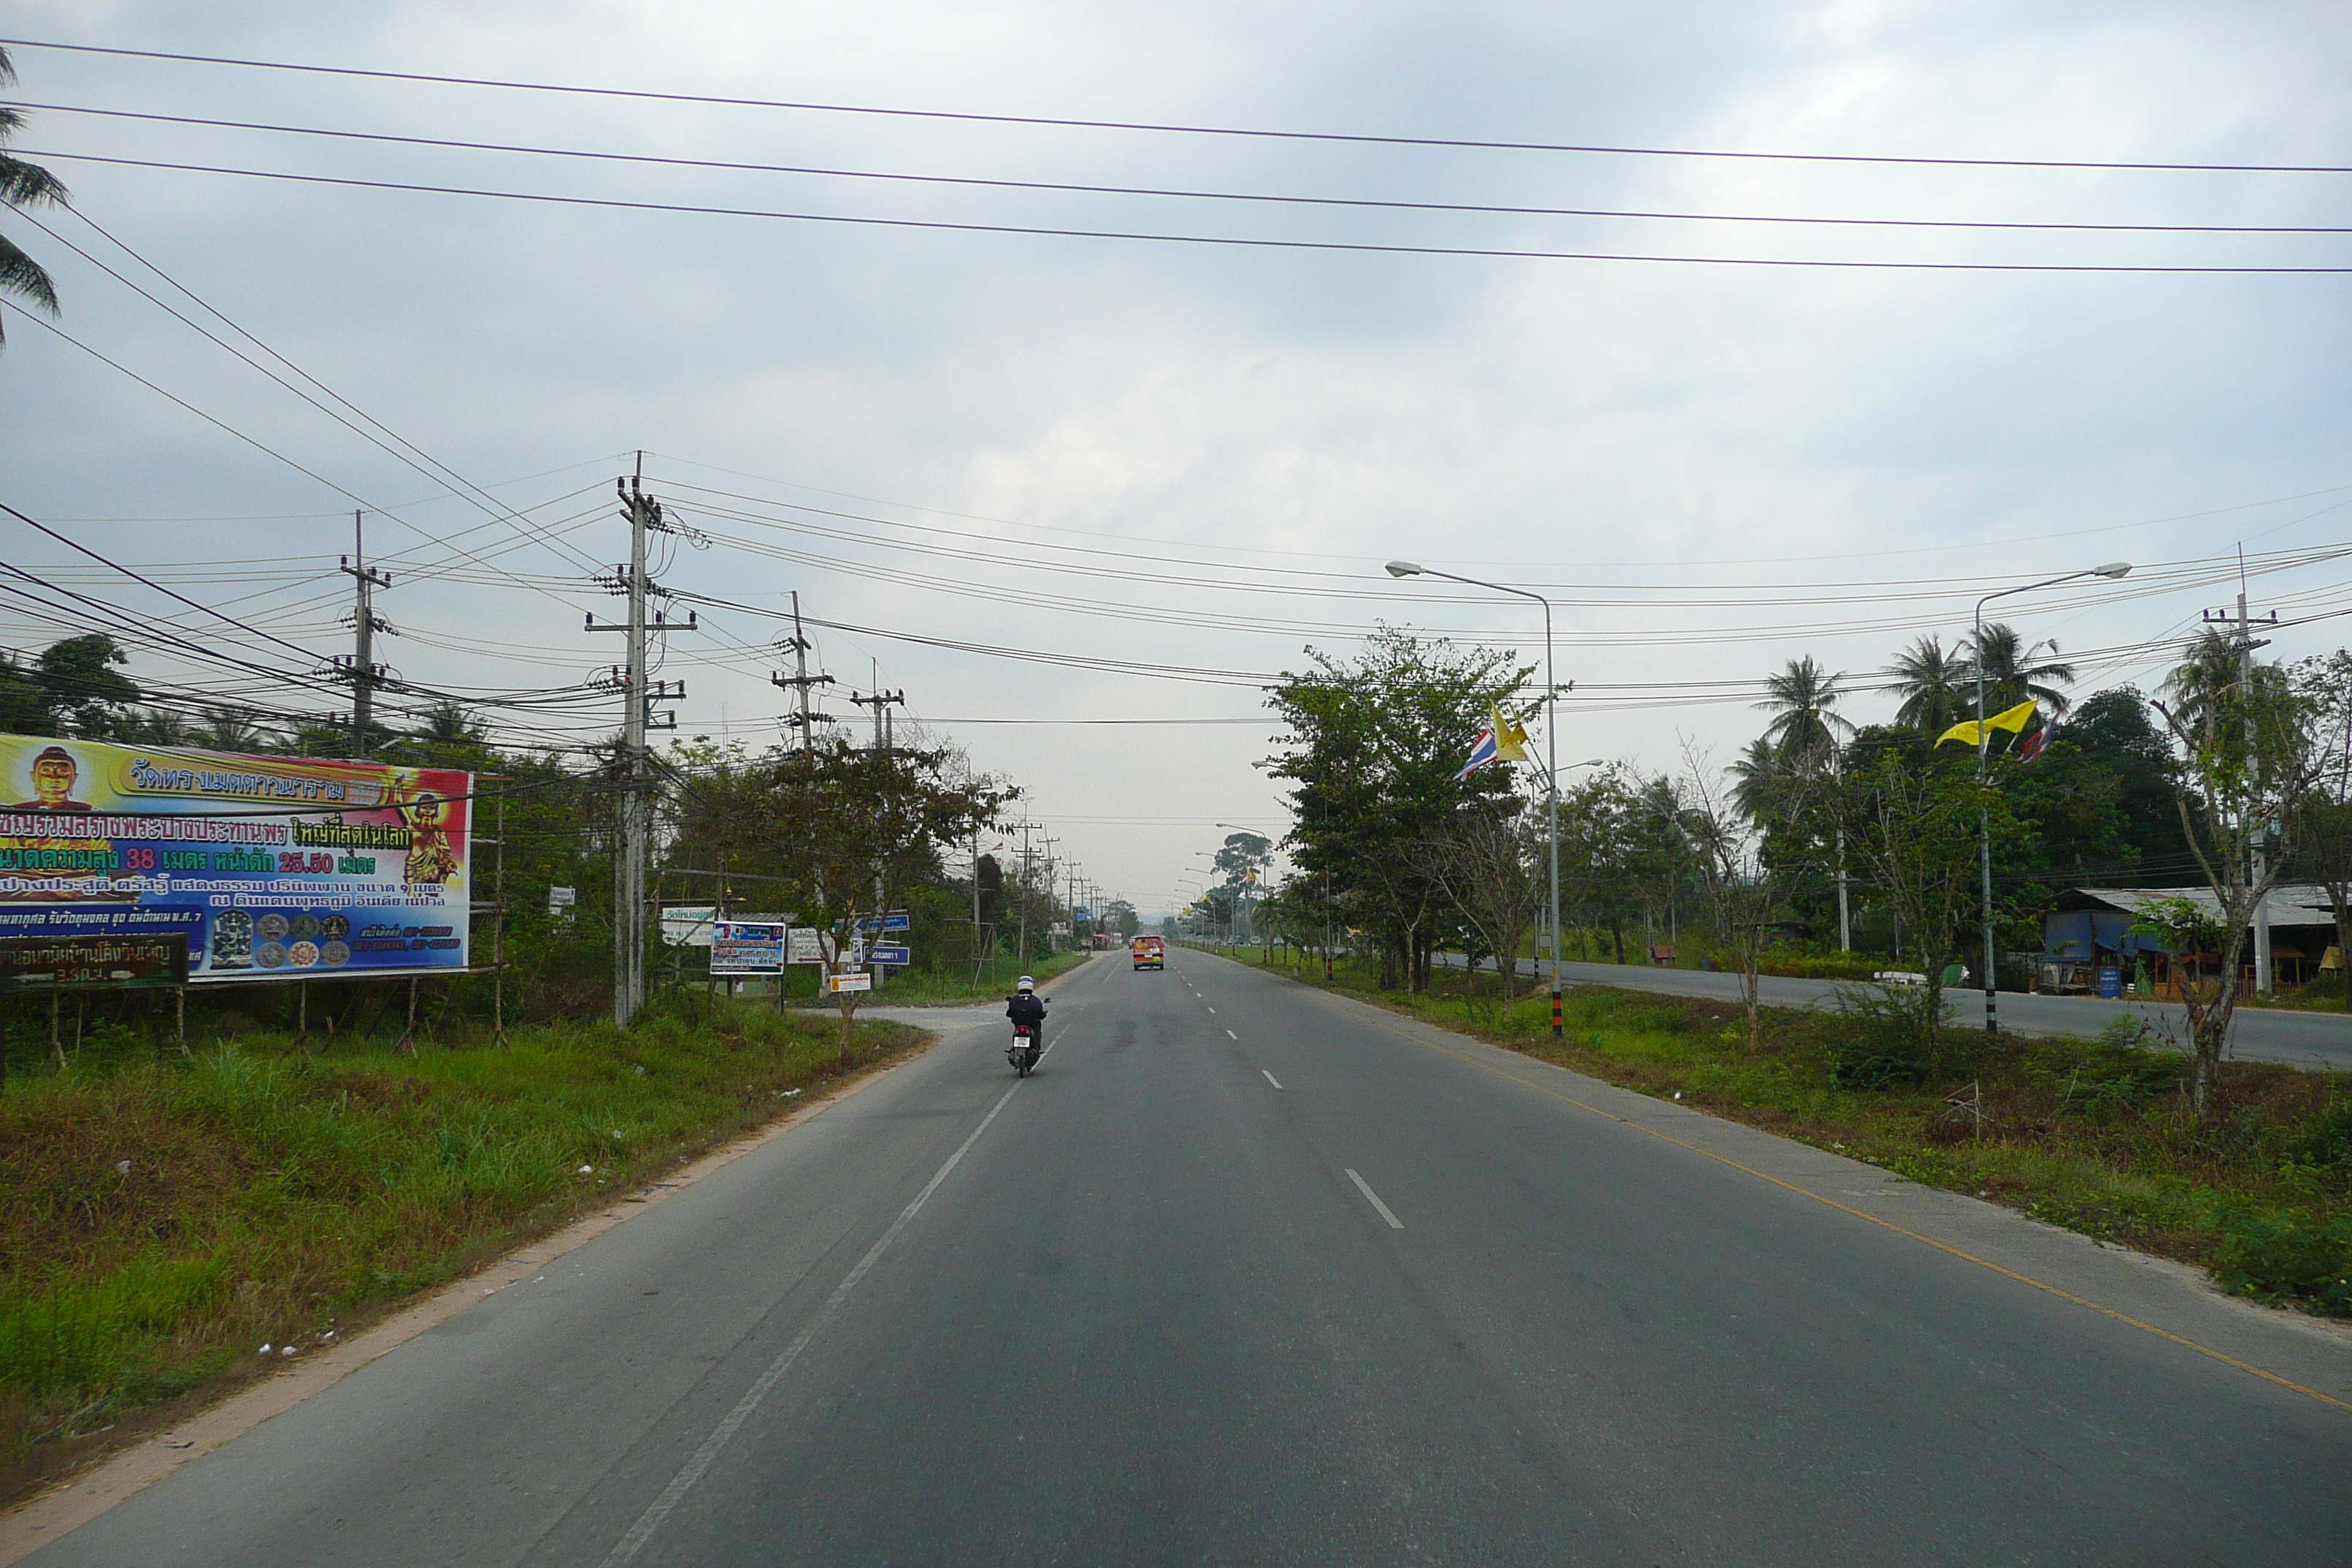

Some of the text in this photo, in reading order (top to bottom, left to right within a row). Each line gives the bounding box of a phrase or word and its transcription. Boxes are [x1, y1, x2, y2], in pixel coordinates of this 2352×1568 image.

[126, 848, 155, 869] 38
[162, 851, 207, 870] เมตร
[214, 847, 274, 872] หน้าตัก
[279, 852, 333, 873] 25.50
[338, 856, 375, 874] เมตร
[173, 878, 264, 892] แสดงธรรม
[355, 883, 396, 893] ขนาด
[413, 883, 445, 893] เมตร
[210, 895, 229, 906] ณ
[356, 894, 401, 907] อินเดีย
[405, 896, 445, 907] เนปาล
